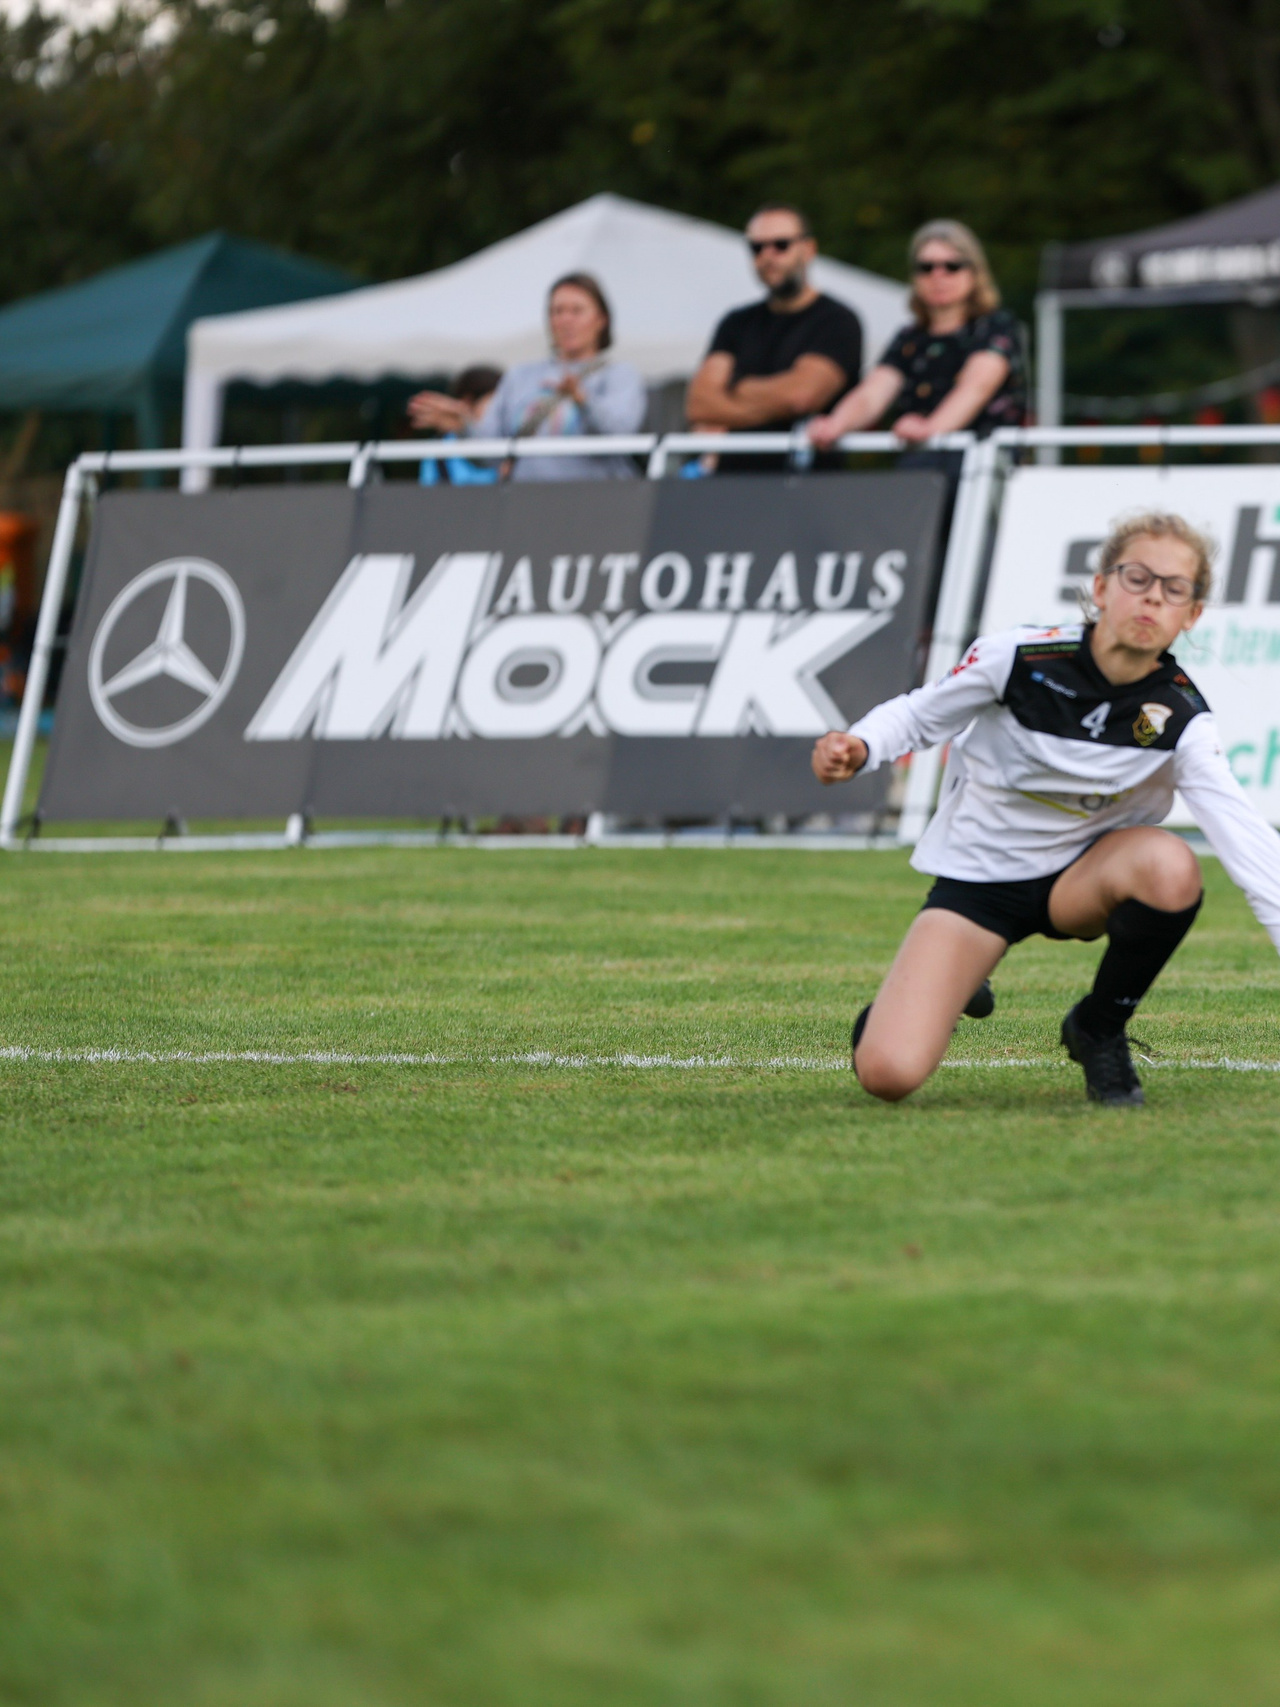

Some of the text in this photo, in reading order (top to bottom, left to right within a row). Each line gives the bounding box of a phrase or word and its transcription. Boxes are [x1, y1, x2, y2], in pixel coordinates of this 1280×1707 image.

[494, 549, 908, 613] AUTOHAUS
[243, 551, 894, 741] MOCK
[1080, 701, 1112, 738] 4
